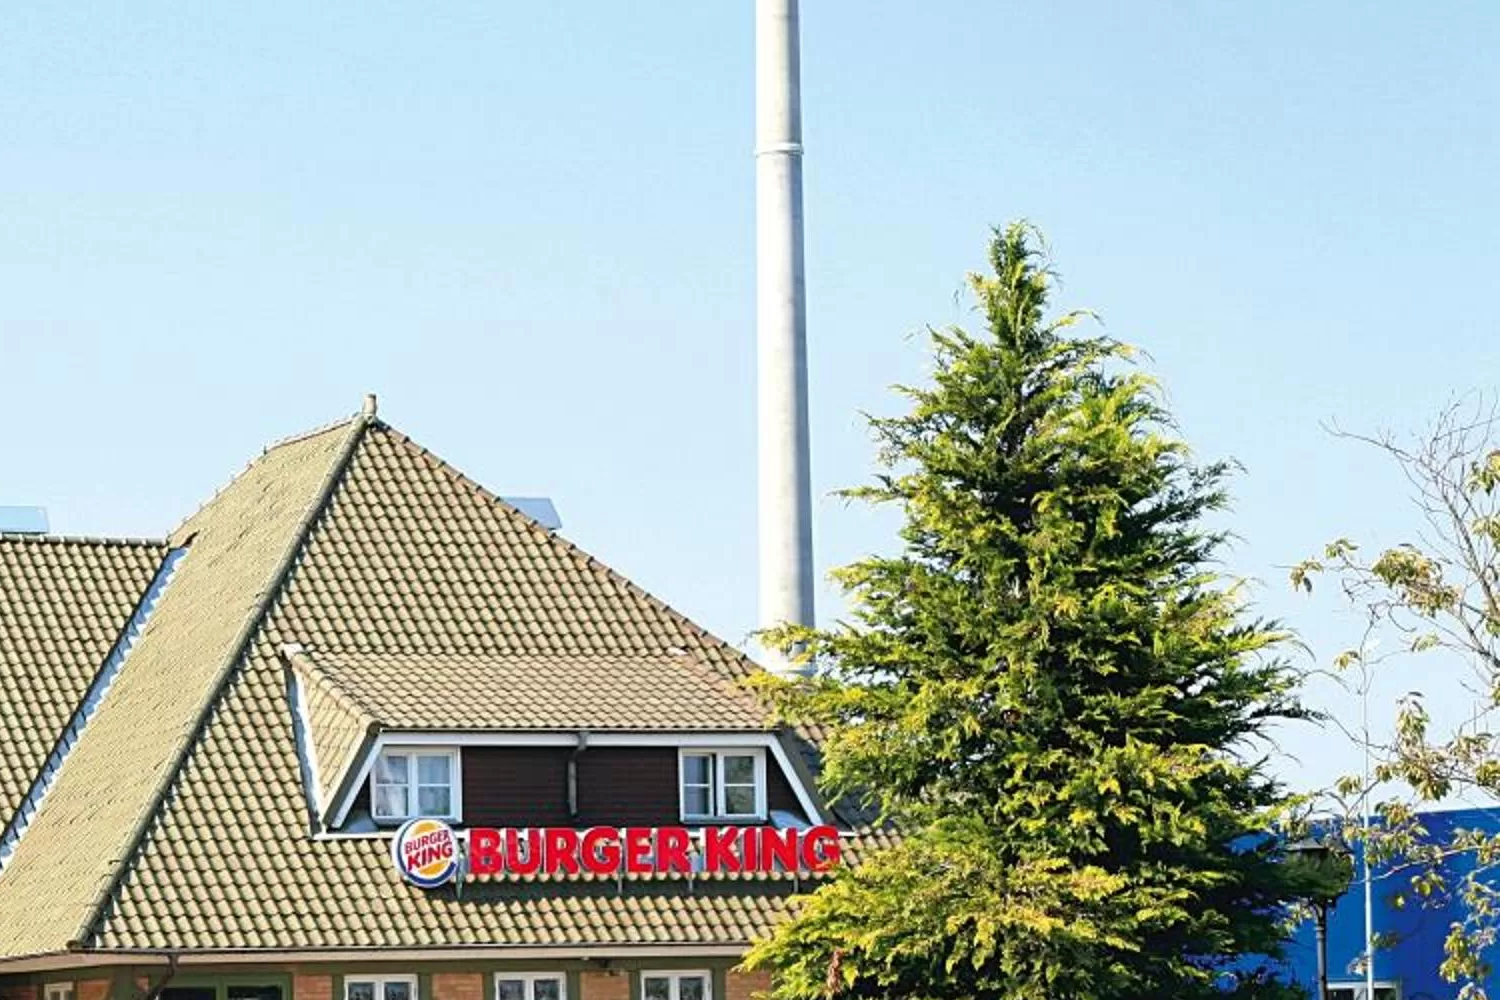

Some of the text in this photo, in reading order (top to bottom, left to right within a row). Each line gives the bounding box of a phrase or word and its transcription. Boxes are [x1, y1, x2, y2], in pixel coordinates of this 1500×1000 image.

[404, 830, 451, 854] BURGER
[468, 825, 841, 876] BURGER KING
[406, 845, 453, 872] KING
